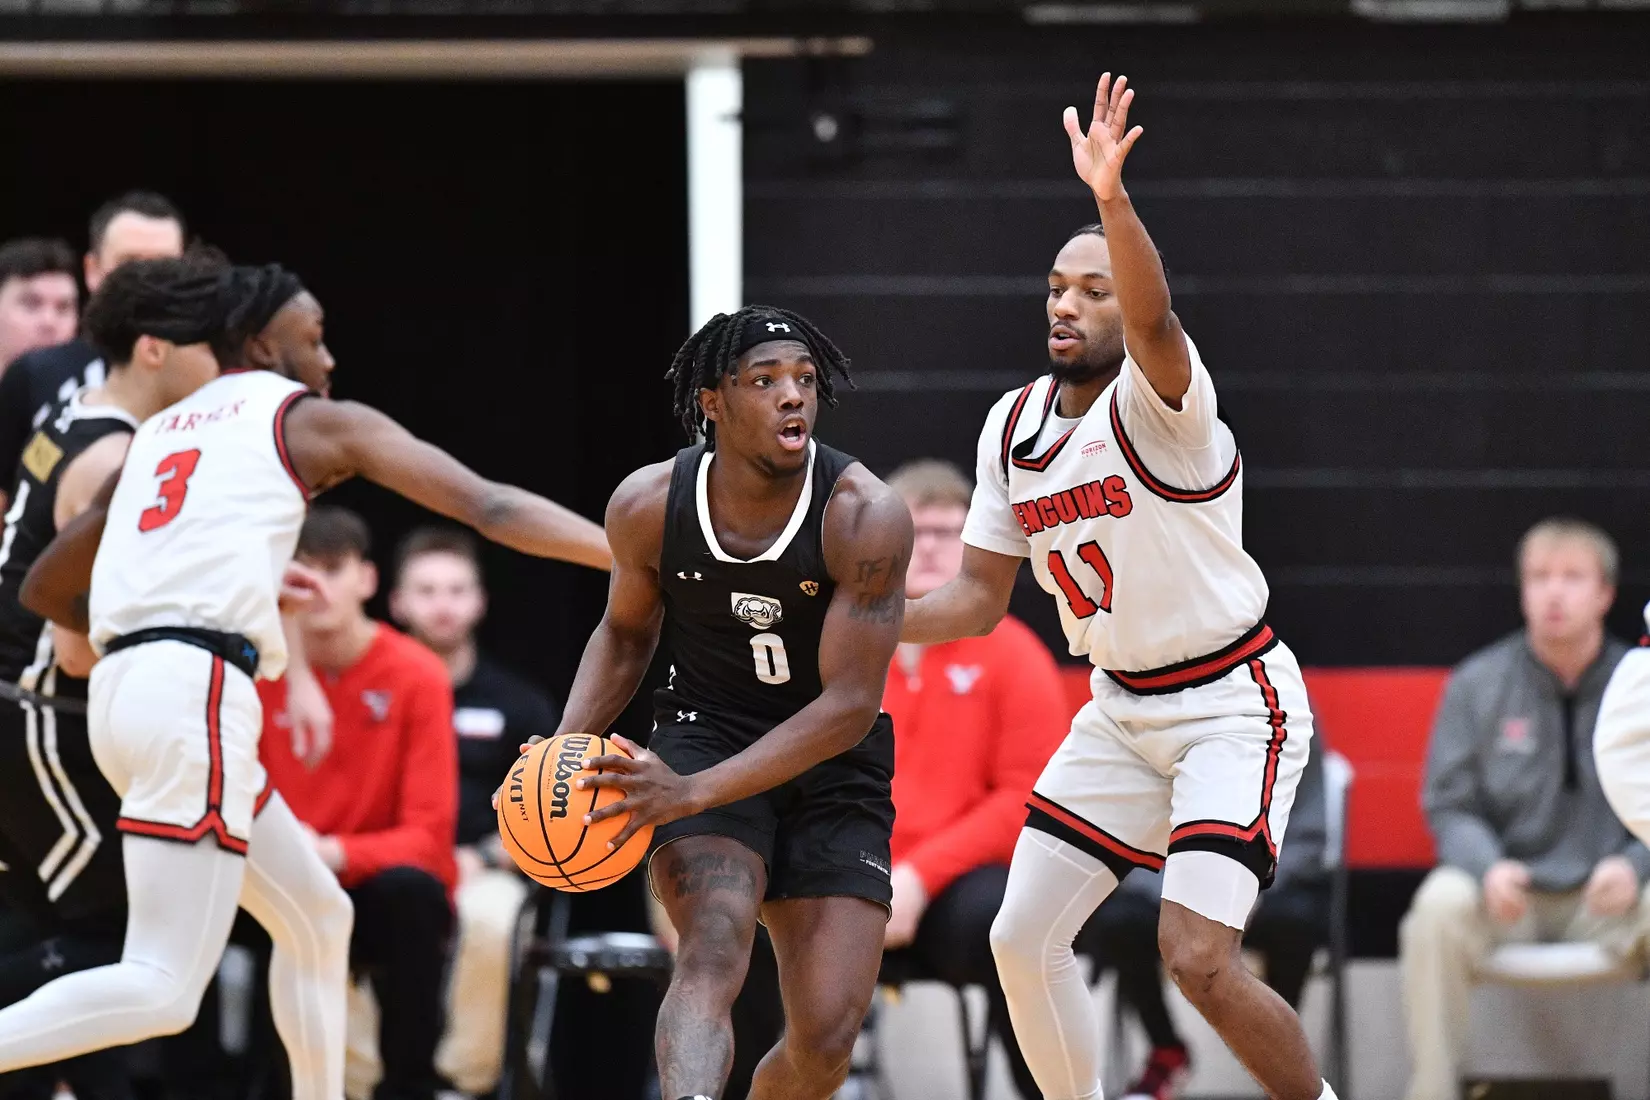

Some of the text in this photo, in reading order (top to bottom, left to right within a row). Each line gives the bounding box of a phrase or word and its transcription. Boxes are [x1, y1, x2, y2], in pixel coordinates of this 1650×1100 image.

[138, 448, 201, 532] 3
[1047, 540, 1114, 619] 11
[749, 633, 791, 685] 0
[511, 754, 529, 803] EVO
[550, 736, 592, 819] Wilson
